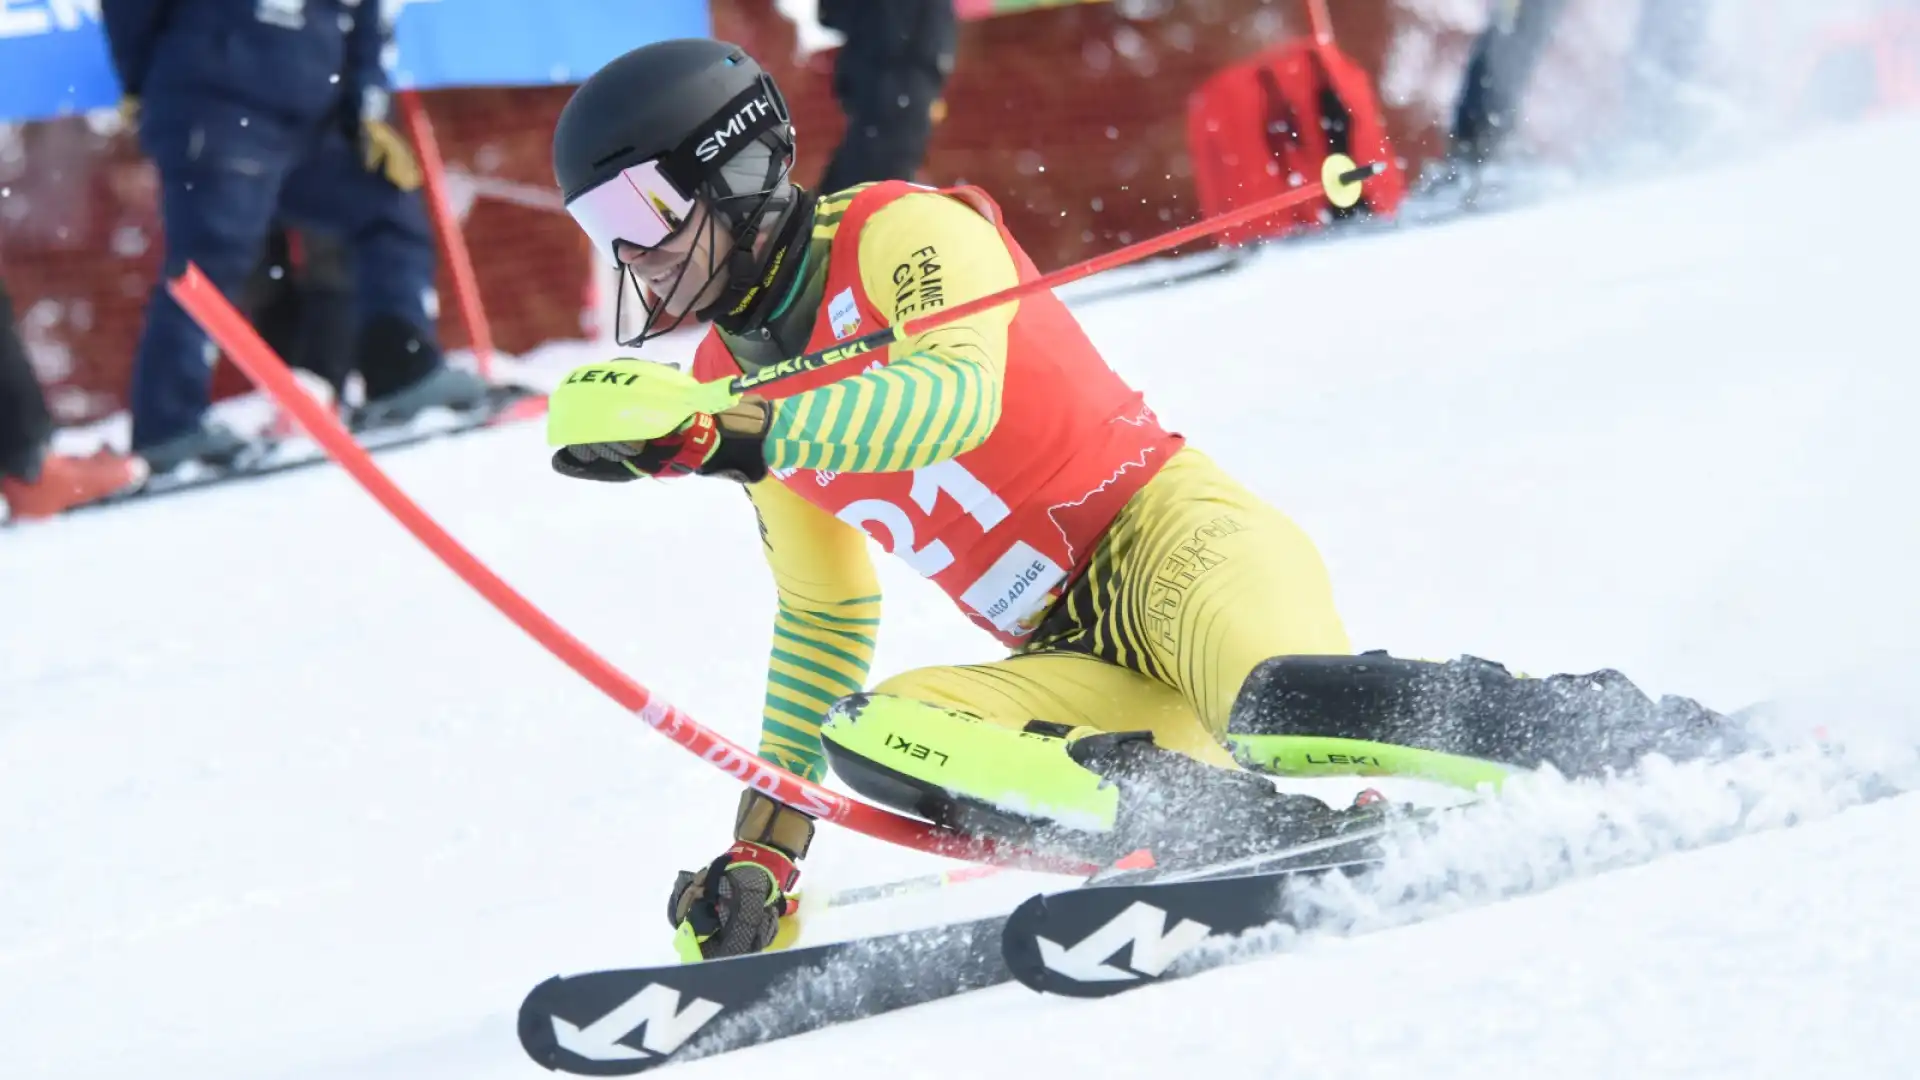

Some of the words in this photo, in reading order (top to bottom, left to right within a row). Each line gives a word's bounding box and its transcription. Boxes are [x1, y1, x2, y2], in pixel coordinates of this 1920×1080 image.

[695, 95, 769, 162] SMITH
[566, 369, 640, 386] LEKI
[740, 356, 803, 388] LEKI
[834, 456, 1012, 578] 21
[884, 733, 949, 767] LEKI
[1305, 752, 1380, 767] LEKI
